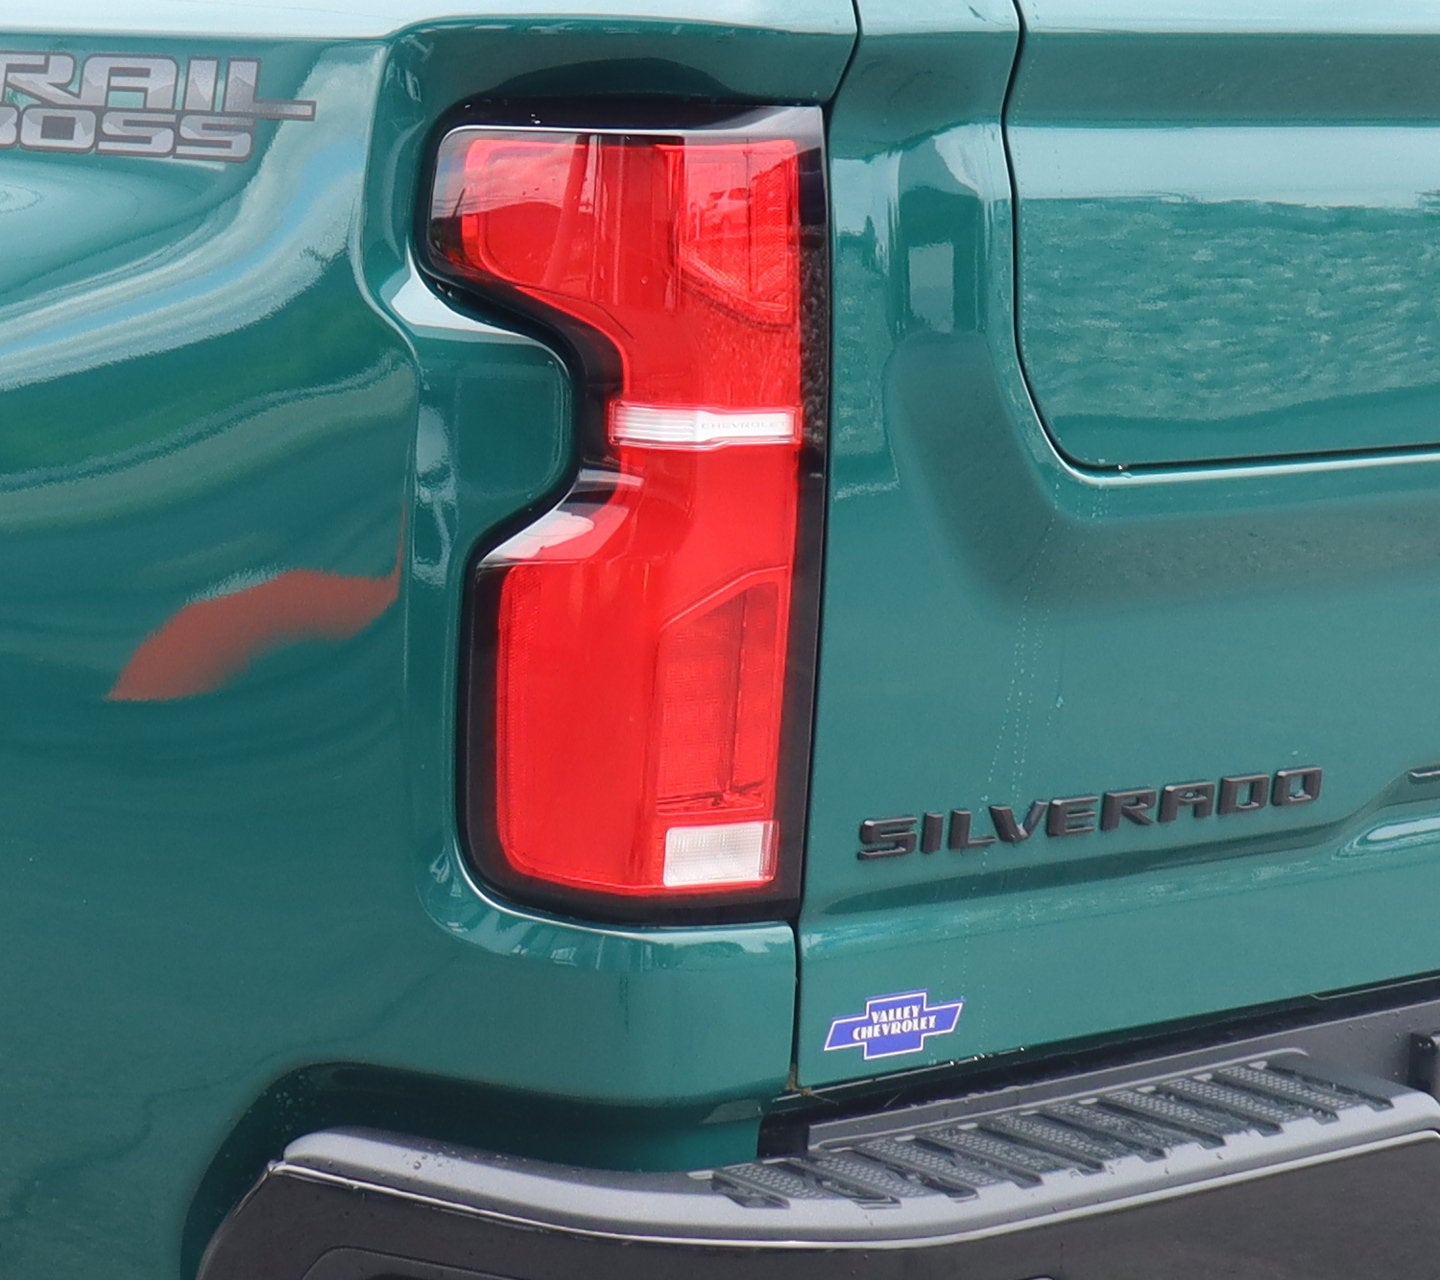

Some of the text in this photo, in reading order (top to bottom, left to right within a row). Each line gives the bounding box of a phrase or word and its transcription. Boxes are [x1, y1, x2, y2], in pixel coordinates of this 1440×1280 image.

[856, 764, 1323, 862] SILVERADO
[851, 1014, 937, 1041] CHEVROLET
[870, 1004, 922, 1024] VALLEY
